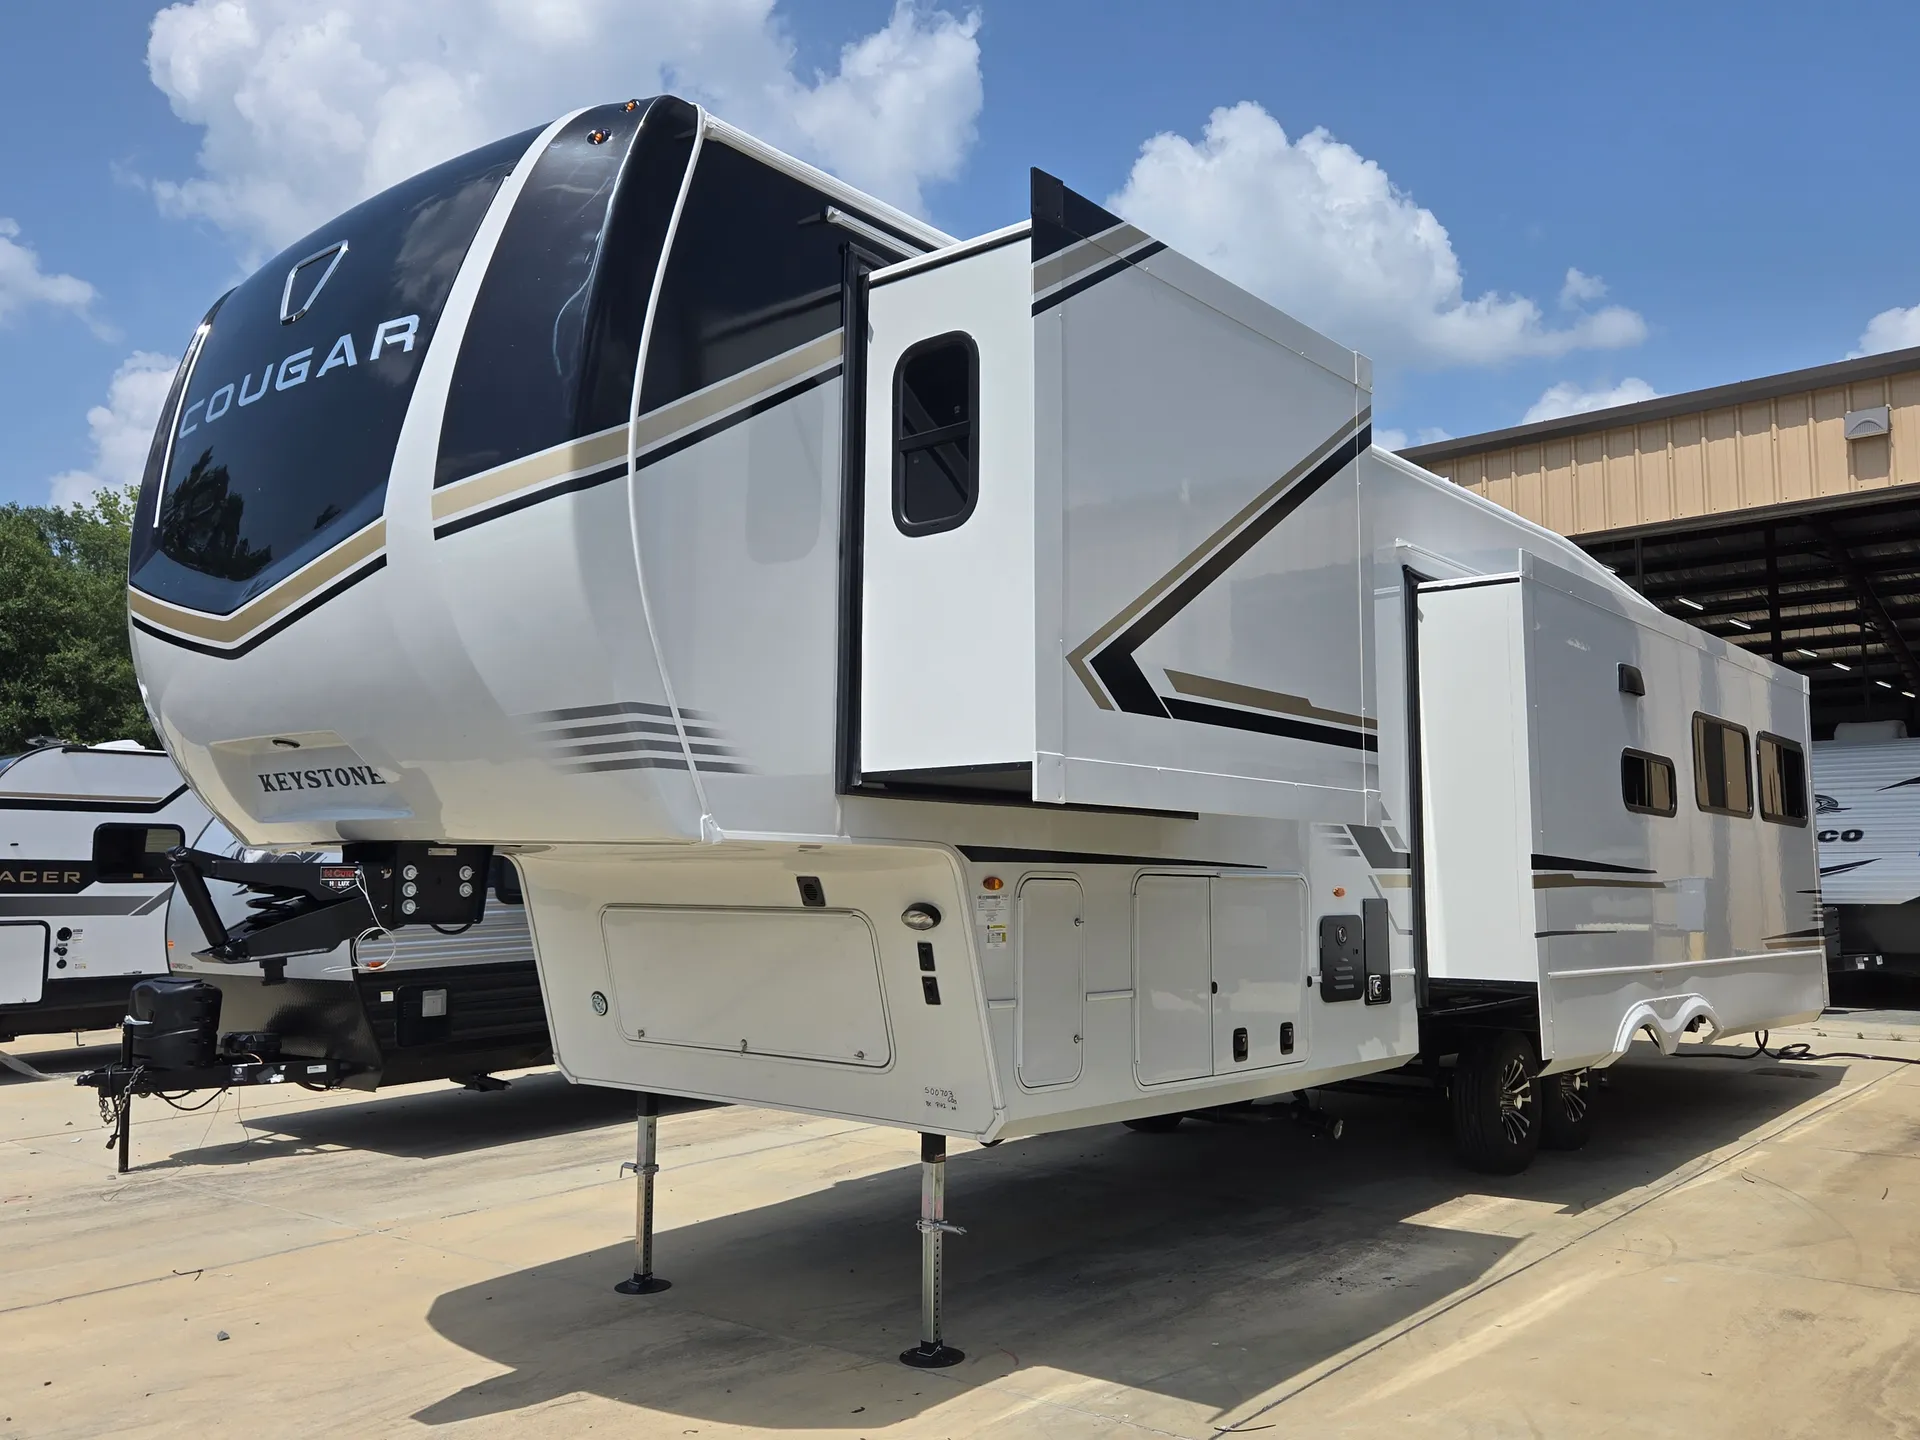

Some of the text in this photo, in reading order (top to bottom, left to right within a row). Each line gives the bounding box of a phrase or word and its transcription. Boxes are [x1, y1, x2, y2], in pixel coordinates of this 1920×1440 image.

[178, 314, 420, 439] COUGAR
[258, 765, 386, 793] KEYSTONE
[0, 870, 81, 884] ACER
